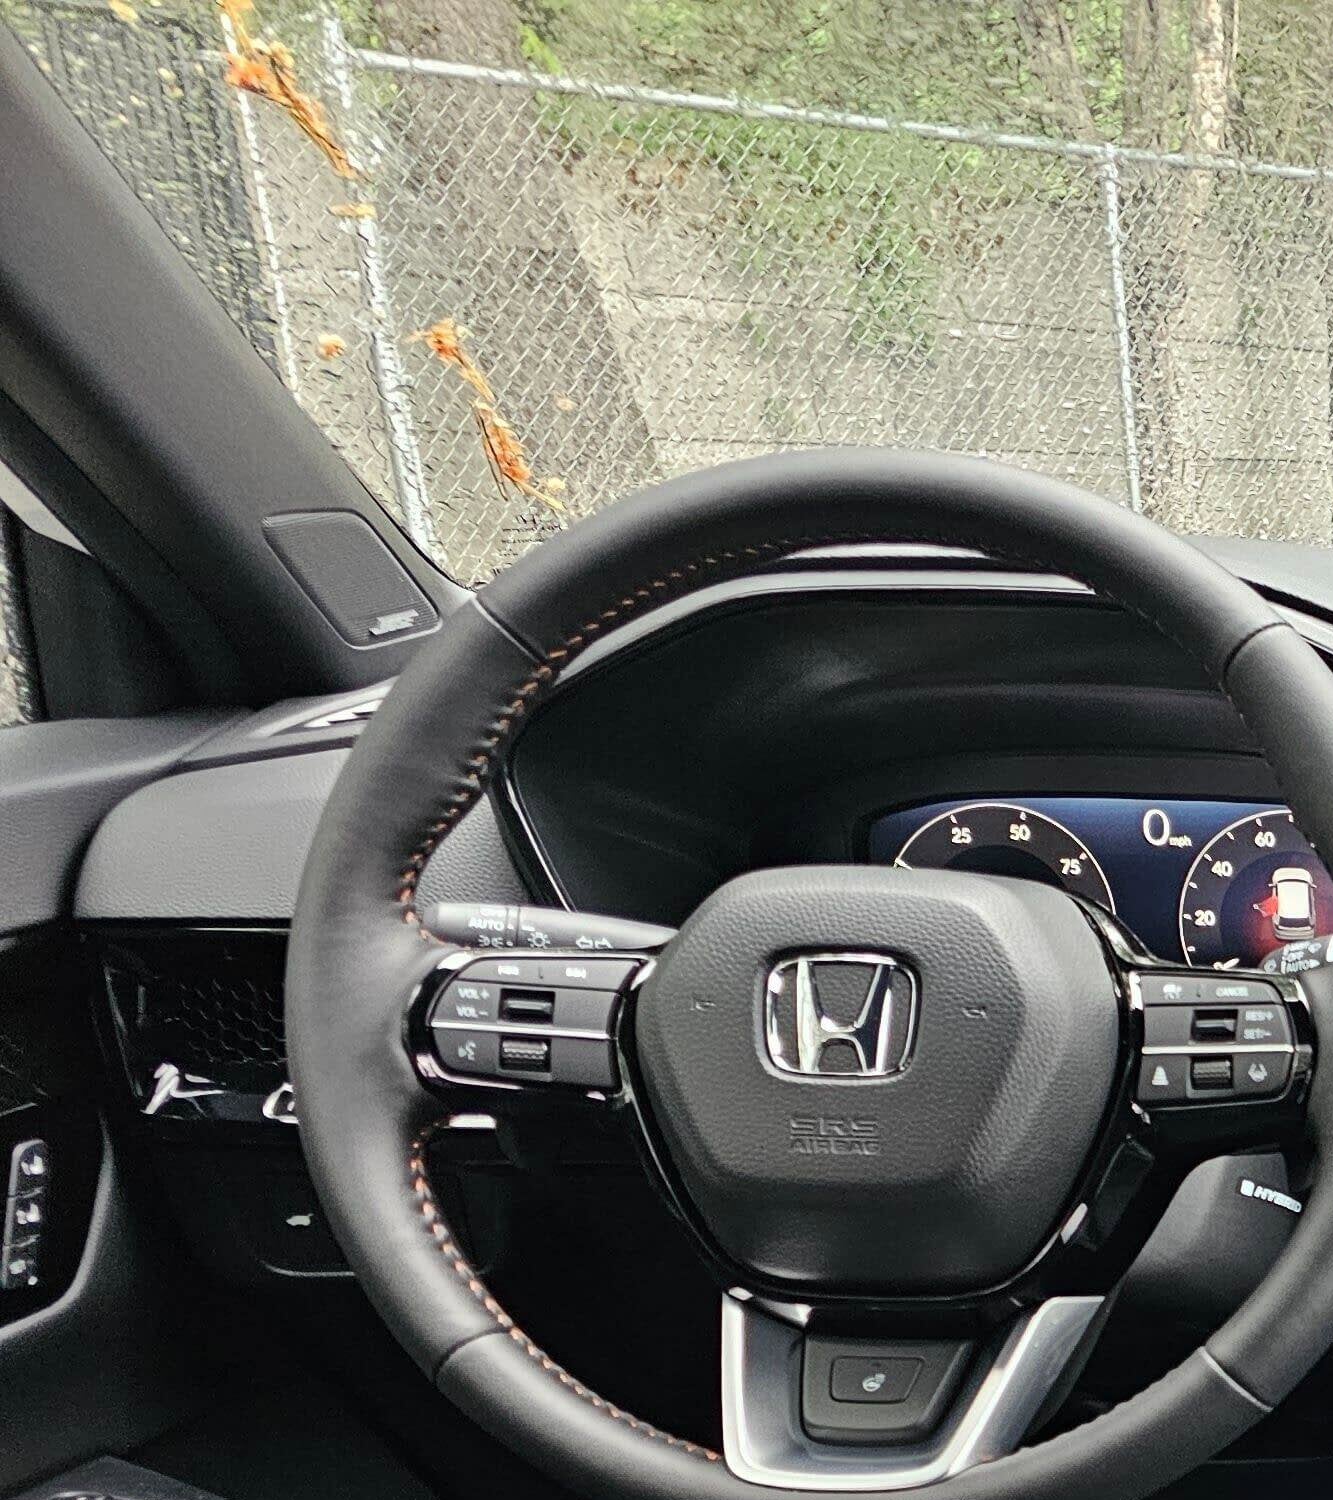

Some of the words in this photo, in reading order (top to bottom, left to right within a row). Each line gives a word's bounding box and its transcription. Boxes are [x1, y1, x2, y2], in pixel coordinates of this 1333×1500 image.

[951, 825, 973, 845] 25
[1009, 823, 1031, 842] 50
[1143, 809, 1172, 848] 0
[1170, 834, 1193, 850] mph
[1254, 831, 1276, 849] 60
[1059, 857, 1082, 876] 75
[1211, 858, 1234, 878] 40
[468, 916, 505, 931] AUTO
[1194, 908, 1217, 927] 20
